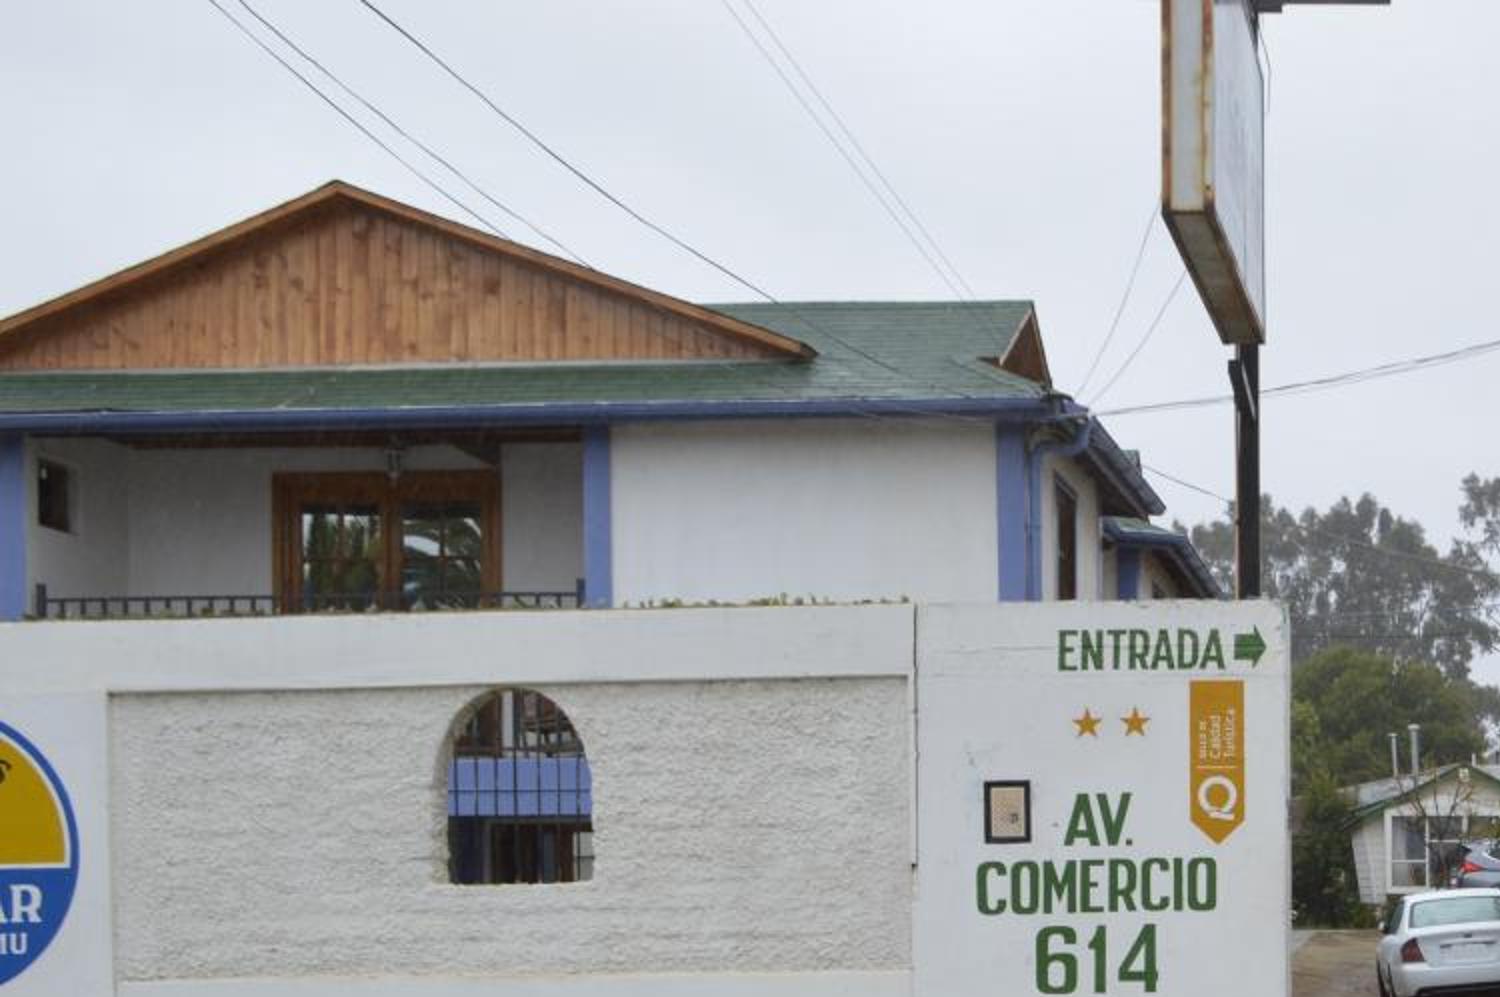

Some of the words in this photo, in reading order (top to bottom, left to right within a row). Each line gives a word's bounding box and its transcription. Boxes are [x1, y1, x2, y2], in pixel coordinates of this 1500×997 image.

[1057, 629, 1226, 671] ENTRADA
[1063, 791, 1133, 847] AV.
[975, 856, 1218, 916] COMERCIO
[1034, 923, 1160, 995] 614
